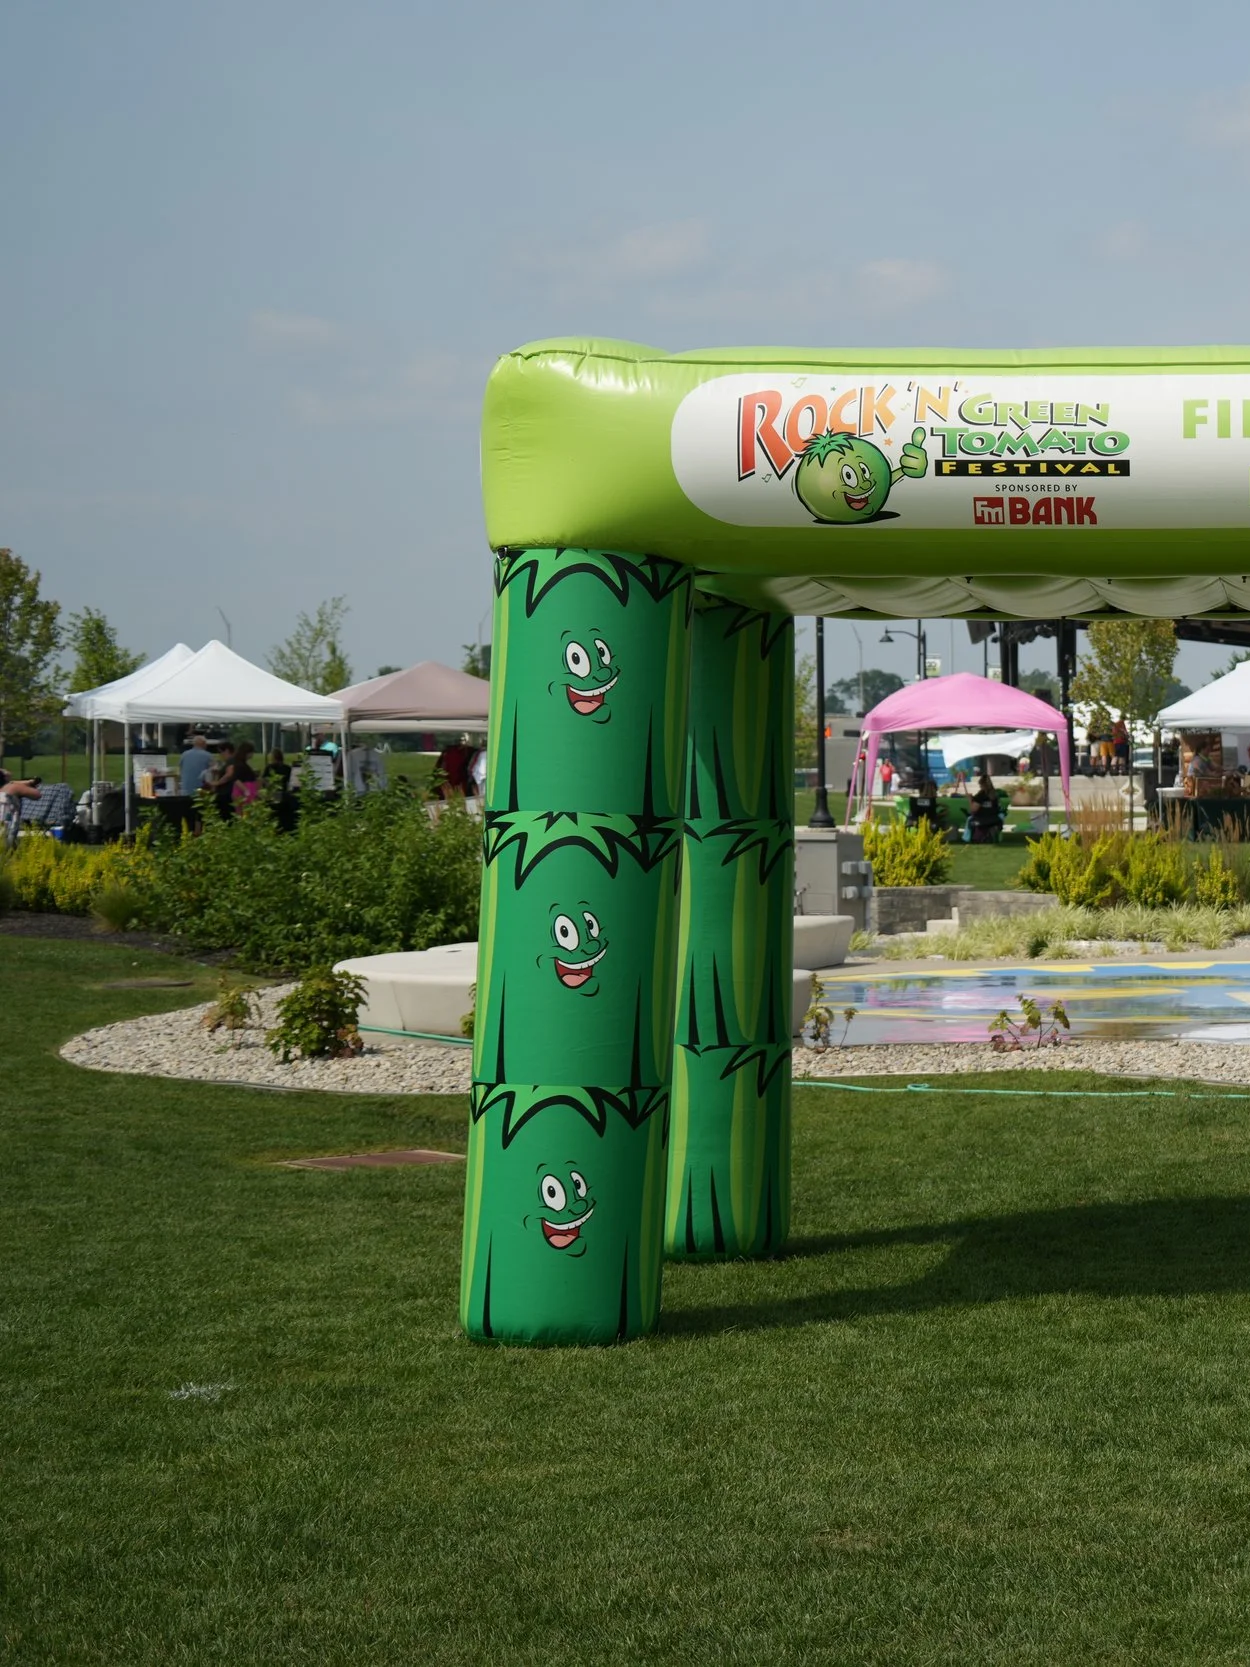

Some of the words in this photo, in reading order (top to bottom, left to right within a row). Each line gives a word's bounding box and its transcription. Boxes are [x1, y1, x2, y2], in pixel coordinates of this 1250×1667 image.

[737, 384, 897, 482] ROCK
[958, 393, 1110, 428] GREEN
[930, 427, 1130, 459] TOMATO
[941, 461, 1121, 476] FESTIVAL
[995, 484, 1061, 492] SPONSORED
[1065, 484, 1078, 492] BY
[1008, 497, 1098, 525] BANK
